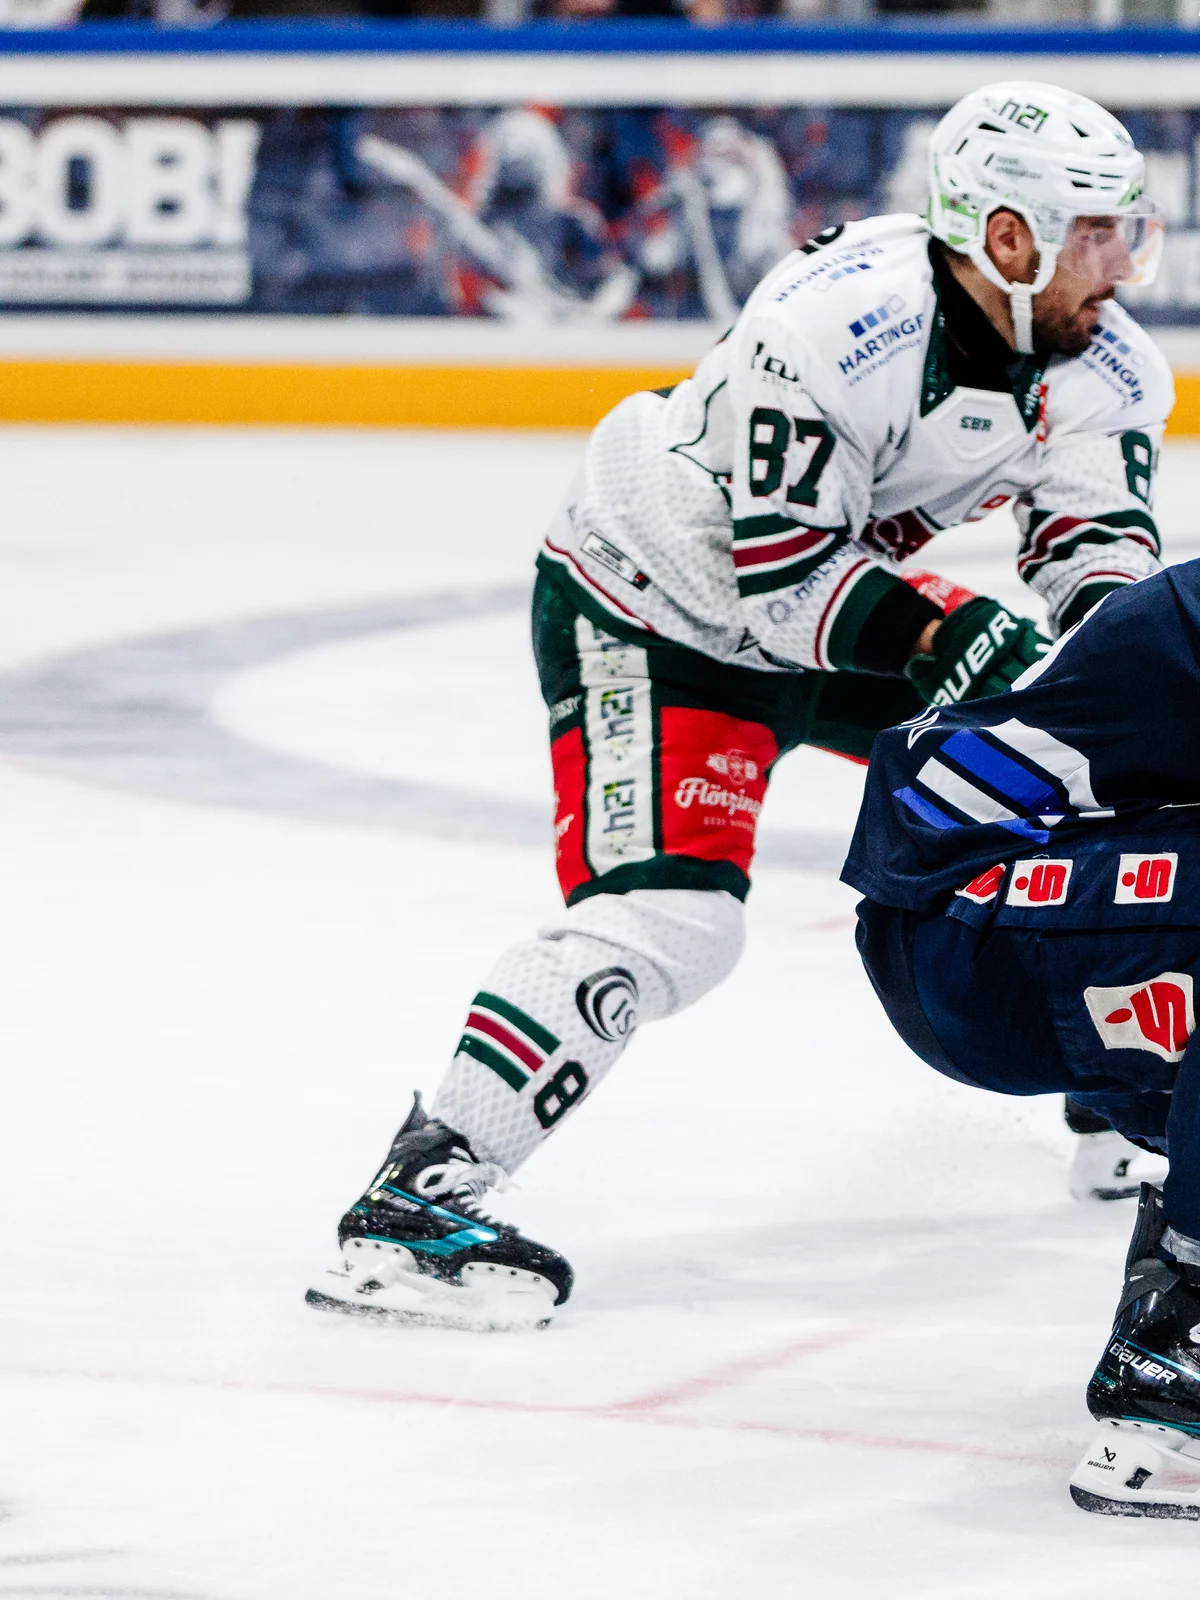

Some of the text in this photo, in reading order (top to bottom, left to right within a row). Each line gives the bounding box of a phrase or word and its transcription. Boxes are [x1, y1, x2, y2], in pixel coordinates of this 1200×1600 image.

[1090, 342, 1144, 405] TINGER
[748, 404, 837, 508] 87
[1120, 430, 1158, 506] 8
[931, 610, 1019, 707] AUER
[1109, 1342, 1178, 1385] BAUER
[1087, 1460, 1116, 1471] BAUER
